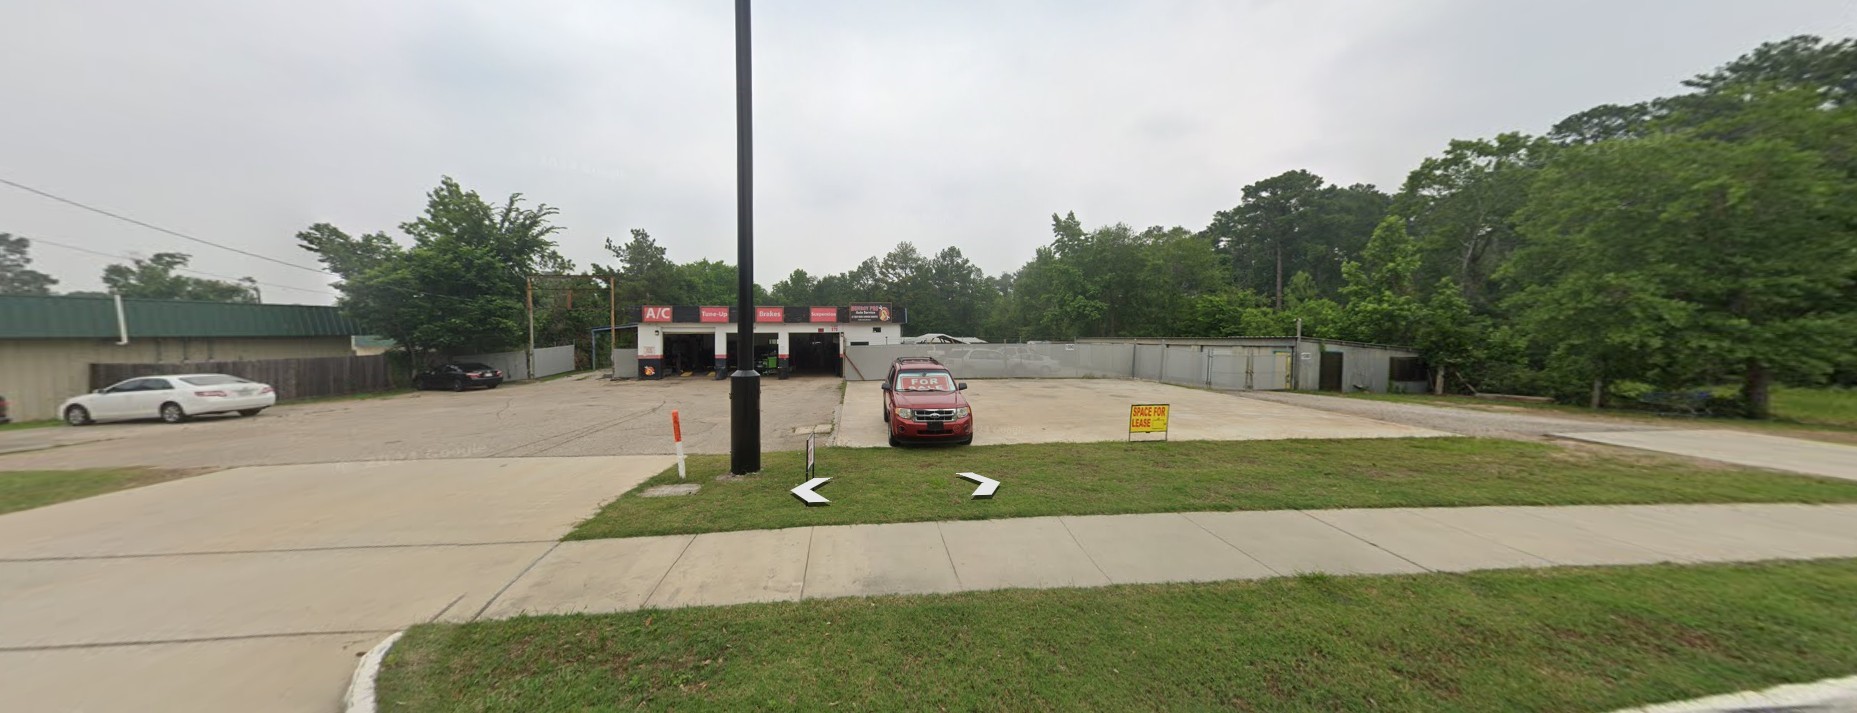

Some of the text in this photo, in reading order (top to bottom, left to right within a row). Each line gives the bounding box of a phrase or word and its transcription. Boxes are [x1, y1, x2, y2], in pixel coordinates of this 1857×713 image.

[645, 307, 671, 319] A/C
[1133, 406, 1166, 416] SPACE FOR
[1132, 418, 1151, 427] LEASE
